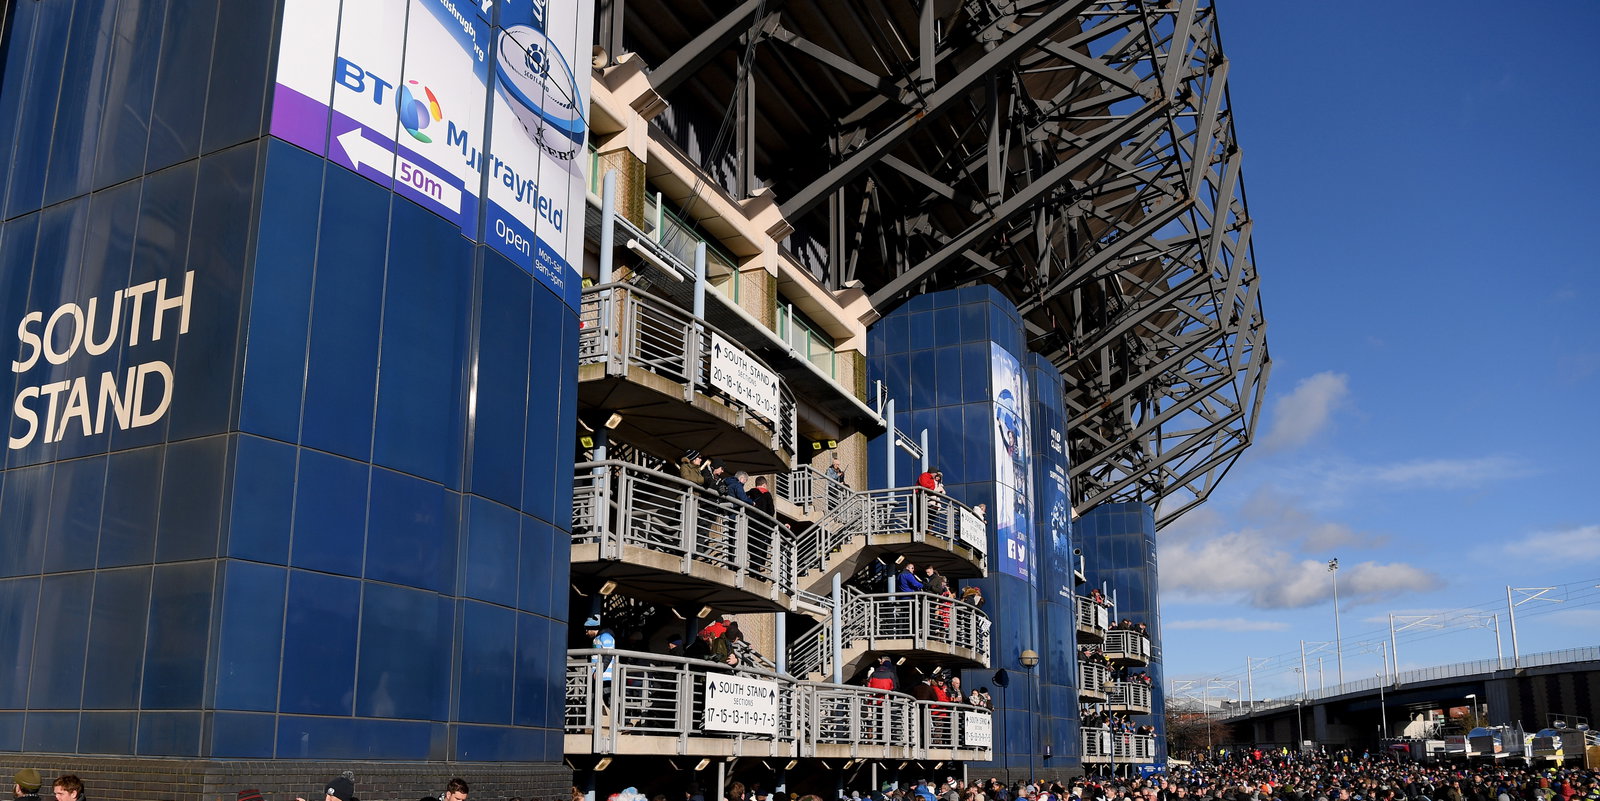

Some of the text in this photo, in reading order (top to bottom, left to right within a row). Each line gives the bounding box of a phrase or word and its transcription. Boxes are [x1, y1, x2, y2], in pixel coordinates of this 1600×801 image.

[335, 56, 393, 106] BT
[400, 161, 442, 200] 50m
[496, 219, 530, 257] Open
[535, 259, 564, 290] 9am-5pm
[538, 247, 562, 275] Mon-Sat
[11, 270, 195, 373] SOUTH
[723, 347, 769, 386] SOUTH STAND
[8, 360, 173, 450] STAND
[719, 681, 767, 698] SOUTH STAND
